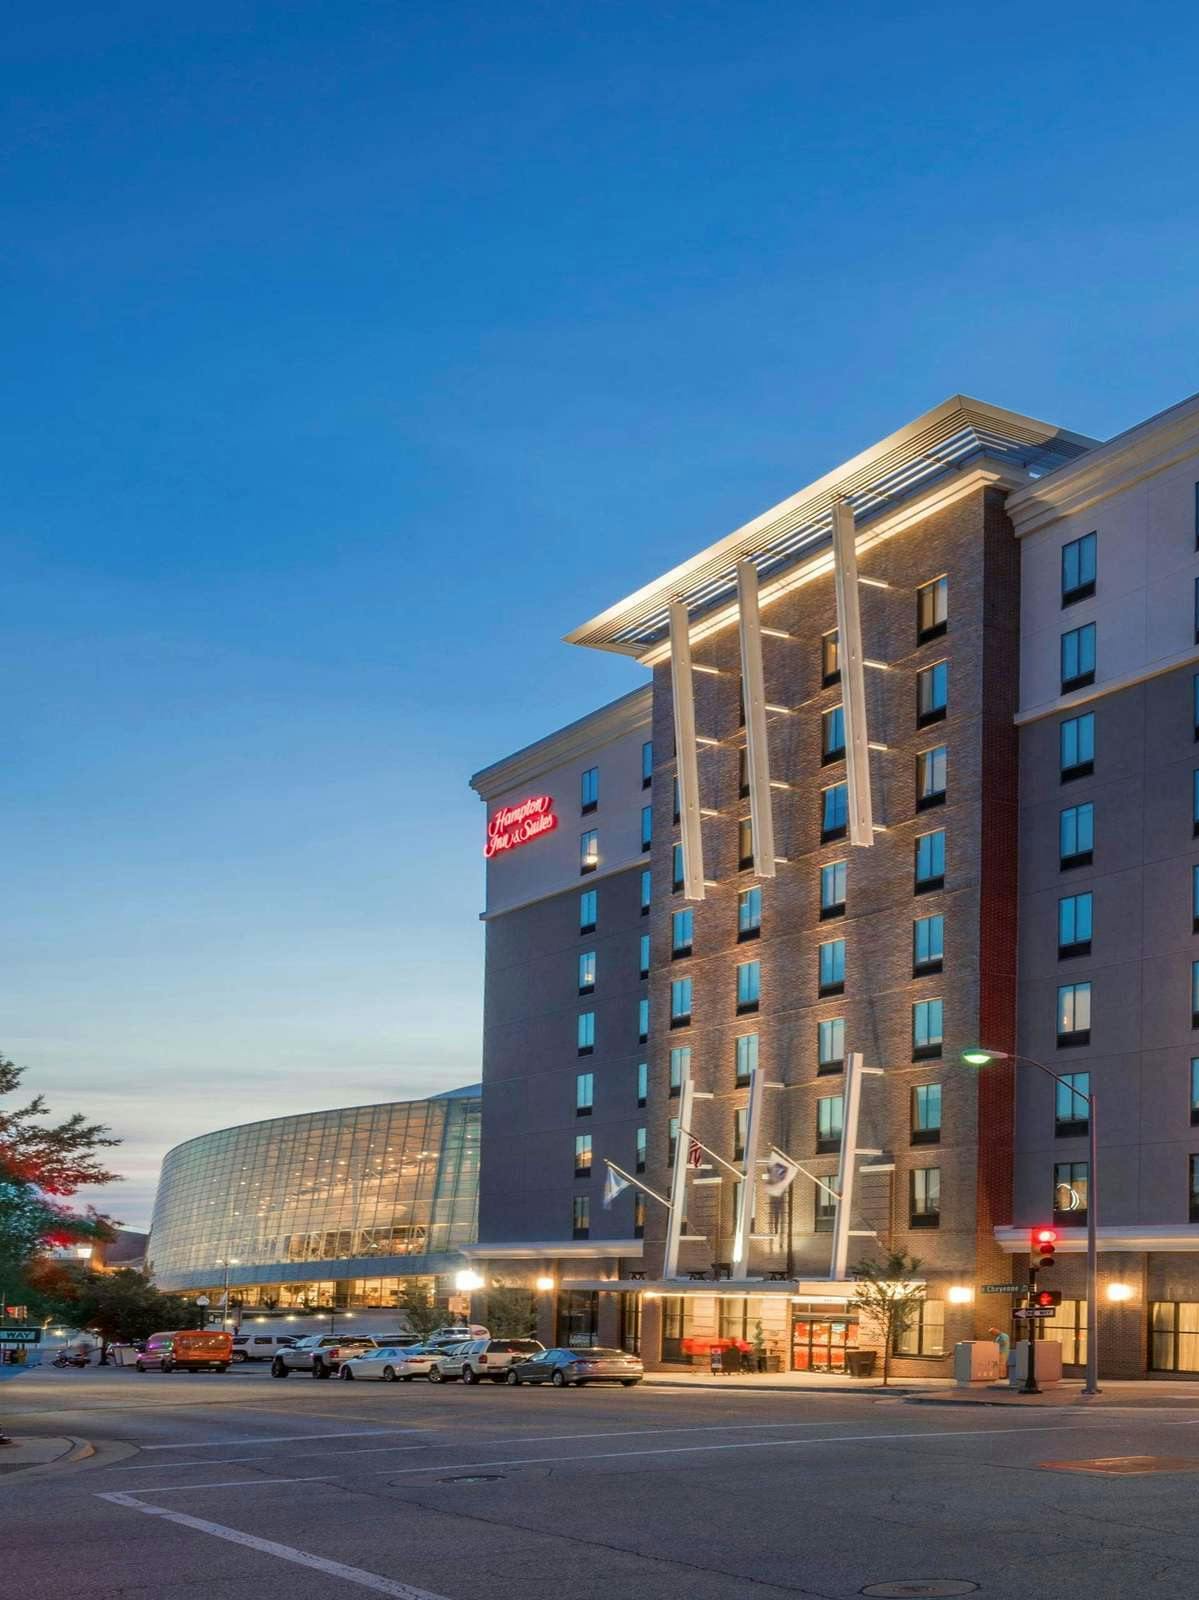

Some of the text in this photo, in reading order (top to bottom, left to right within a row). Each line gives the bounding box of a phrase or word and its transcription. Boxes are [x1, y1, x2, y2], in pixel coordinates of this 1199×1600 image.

[484, 833, 513, 857] Inn
[520, 814, 553, 840] Suites
[488, 796, 549, 837] Hampton
[986, 1285, 1018, 1293] Cheyenne
